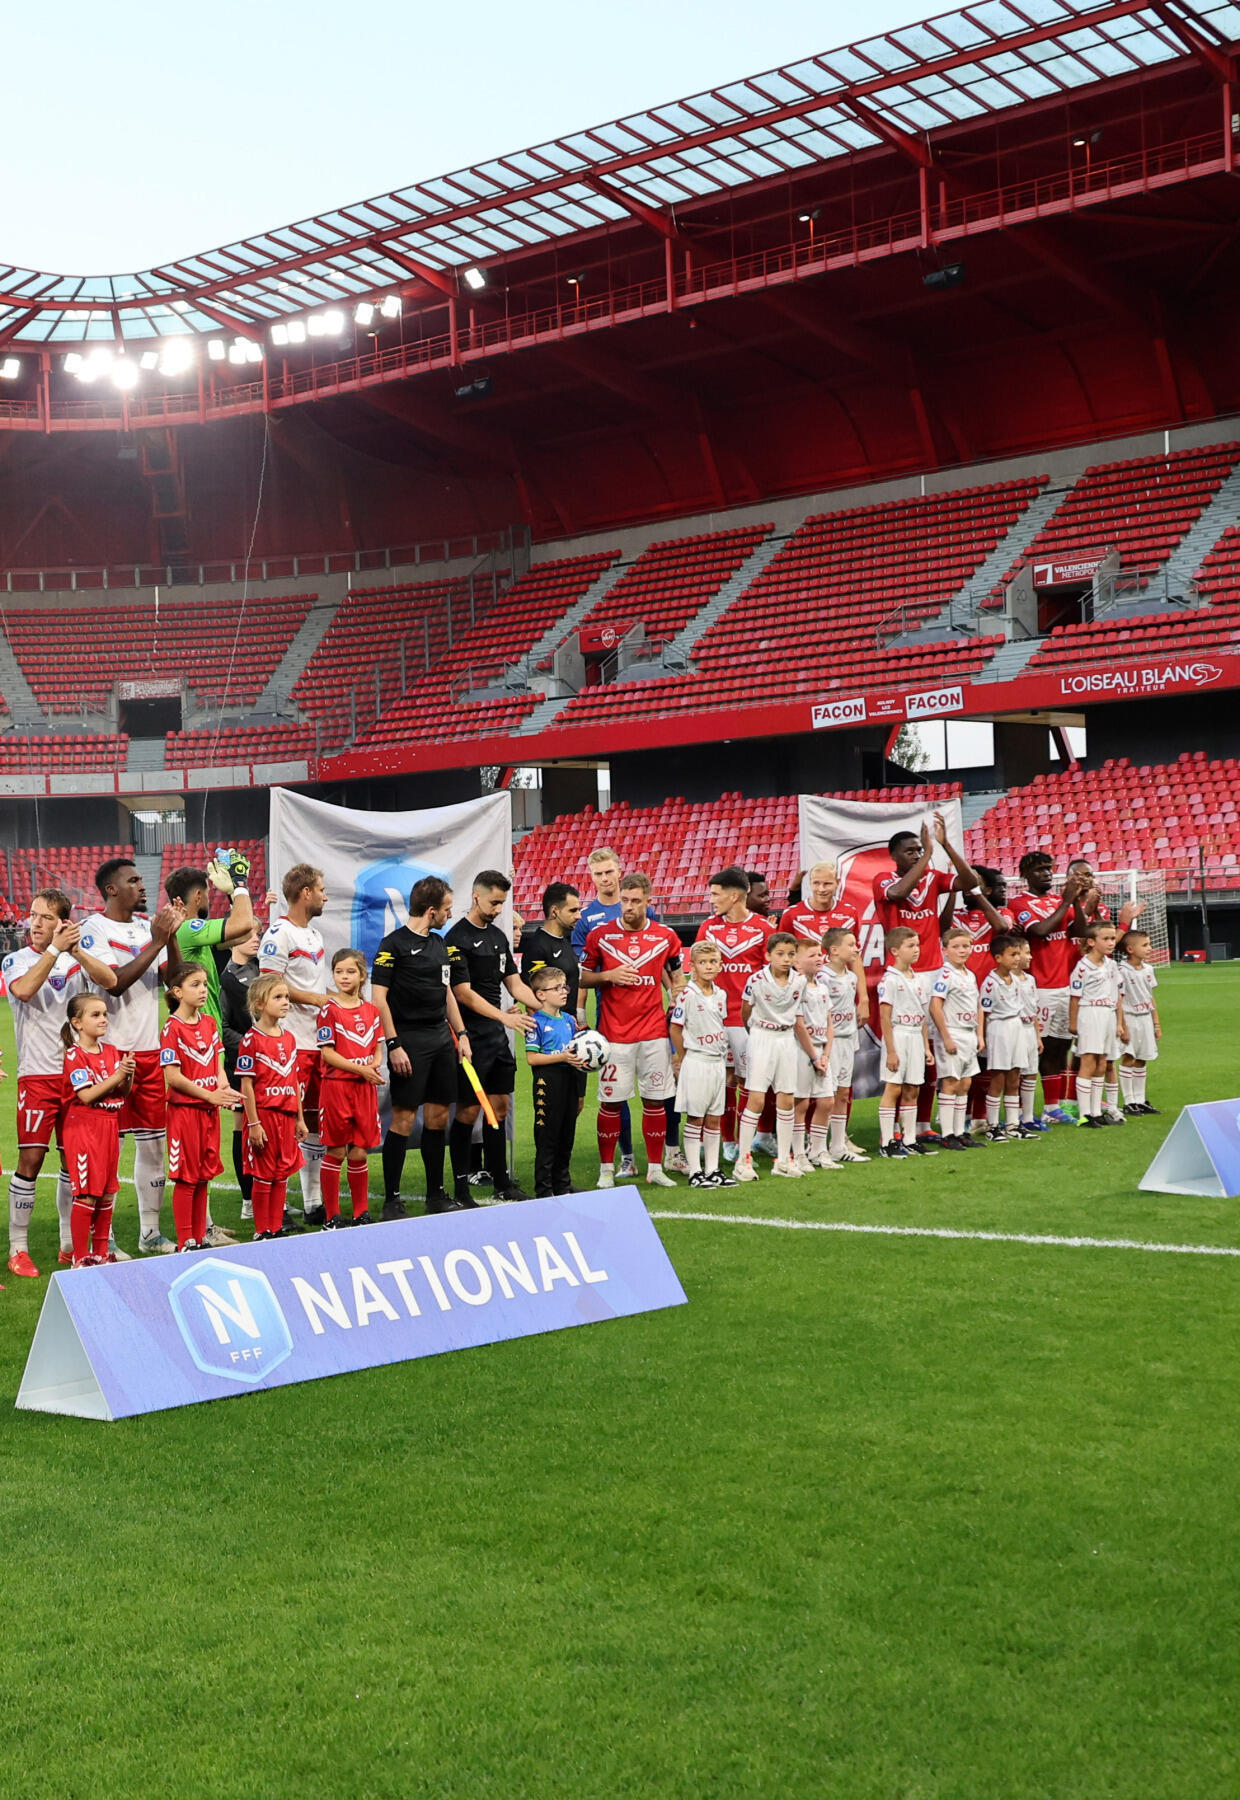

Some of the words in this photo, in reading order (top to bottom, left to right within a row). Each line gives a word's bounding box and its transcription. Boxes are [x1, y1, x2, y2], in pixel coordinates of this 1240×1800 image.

[1116, 684, 1166, 694] TRAITEUR
[908, 692, 961, 710] FACON
[814, 704, 864, 721] FACON
[601, 1064, 617, 1082] 22
[25, 1109, 45, 1133] 17
[151, 1179, 165, 1188] US
[290, 1231, 609, 1335] NATIONAL
[193, 1279, 262, 1344] N
[229, 1347, 263, 1364] FFF
